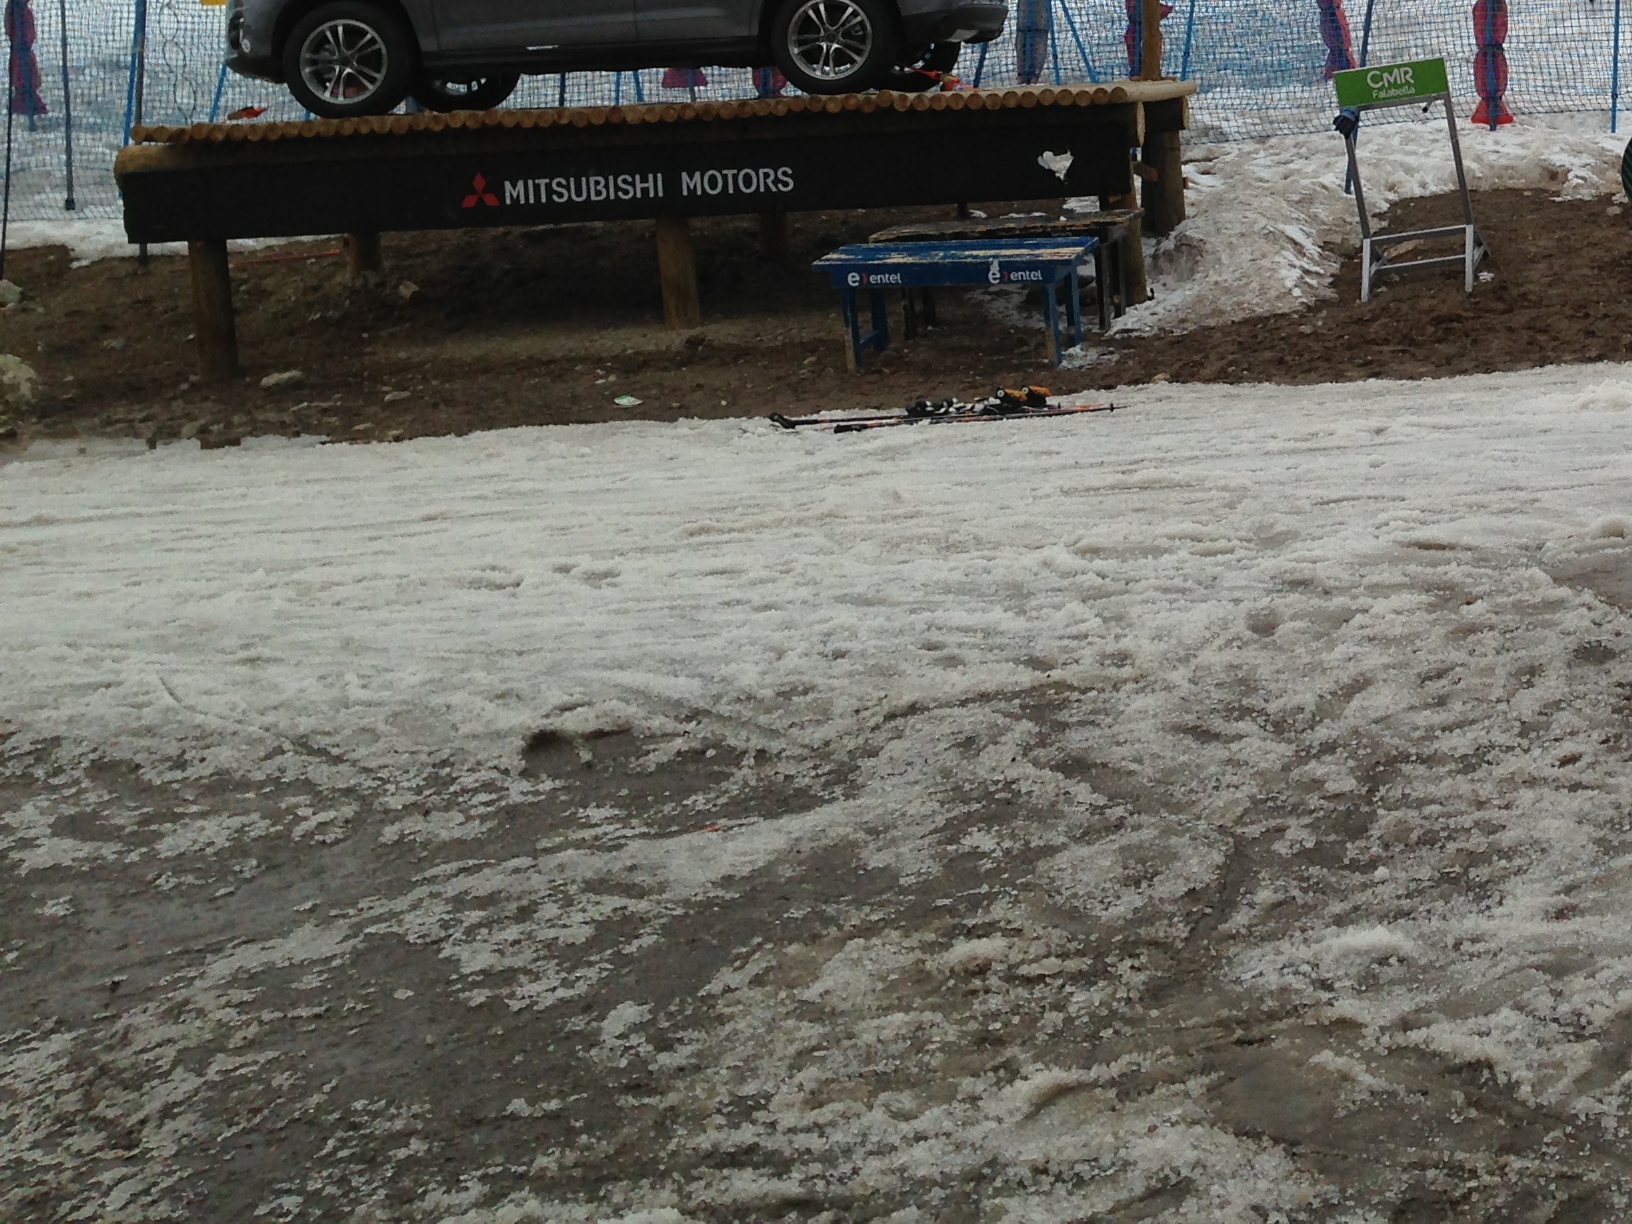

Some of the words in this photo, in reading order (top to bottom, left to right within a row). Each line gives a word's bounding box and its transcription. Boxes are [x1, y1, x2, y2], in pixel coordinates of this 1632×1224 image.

[1366, 67, 1415, 89] CMR
[504, 172, 664, 205] MITSUBISHI
[681, 167, 795, 196] MOTORS
[869, 272, 902, 284] entel
[1010, 269, 1043, 281] entel
